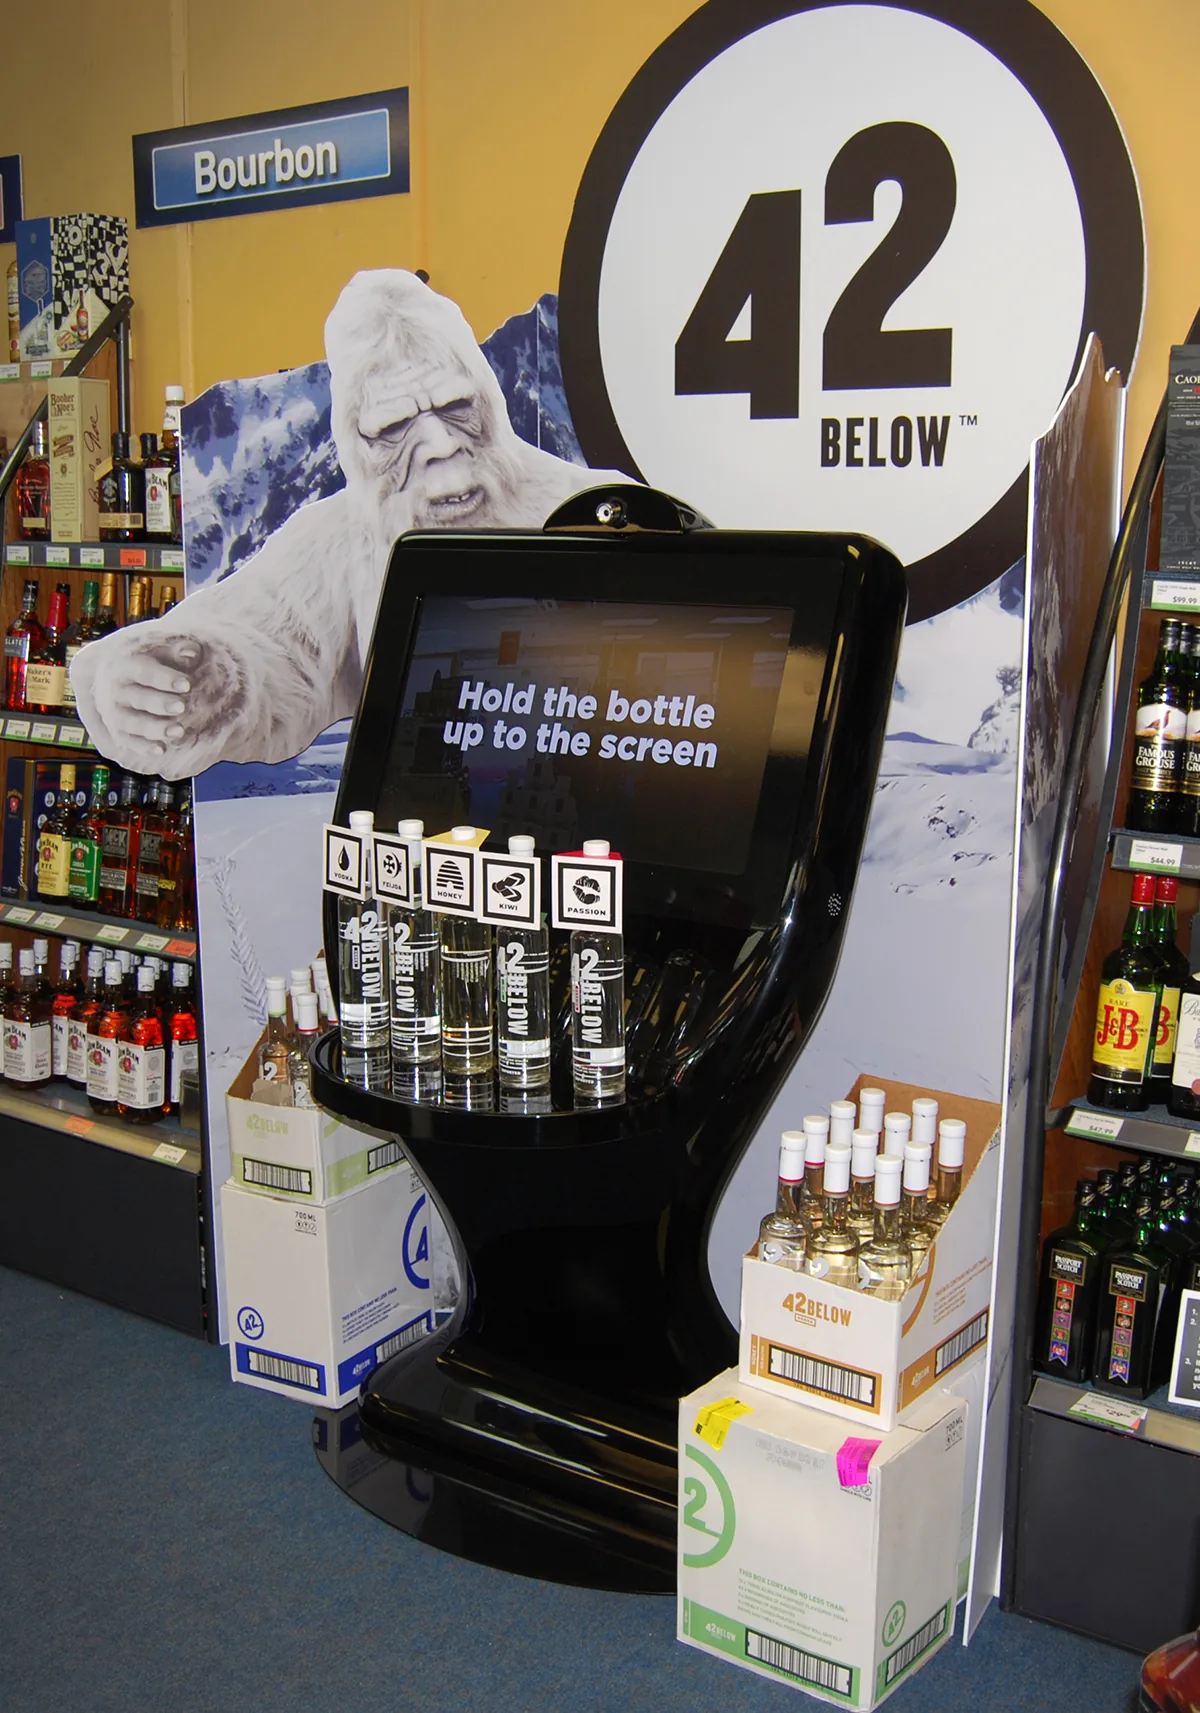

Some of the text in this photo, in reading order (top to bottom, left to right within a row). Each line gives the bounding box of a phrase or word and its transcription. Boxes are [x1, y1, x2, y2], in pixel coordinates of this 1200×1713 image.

[193, 138, 337, 194] Bourbon
[675, 121, 957, 420] 42
[821, 416, 951, 467] BELOW
[1173, 596, 1197, 604] $99.99
[458, 681, 715, 729] Hold the bottle
[443, 720, 718, 768] up to the screen
[1139, 746, 1176, 760] FAMOUS
[1136, 756, 1176, 769] GROUSE
[1151, 857, 1175, 865] $44.99
[334, 872, 353, 881] VODKA
[437, 891, 462, 899] HONEY
[499, 903, 518, 911] KIWI
[567, 907, 606, 916] PASSION
[344, 910, 379, 943] 42
[361, 941, 381, 997] BELOW
[395, 951, 415, 1013] BELOW
[508, 973, 528, 1036] BELOW
[1108, 998, 1129, 1007] RARE
[580, 979, 602, 1044] BELOW
[1096, 1004, 1139, 1051] J&B
[1089, 1125, 1114, 1134] $47.99
[295, 1211, 307, 1220] 700
[1055, 1255, 1082, 1268] PASSPORT
[1056, 1263, 1078, 1274] SCOTCH
[1115, 1270, 1143, 1284] PASSPORT
[1116, 1279, 1139, 1290] SCOTCH
[782, 1292, 852, 1327] 42BELOW
